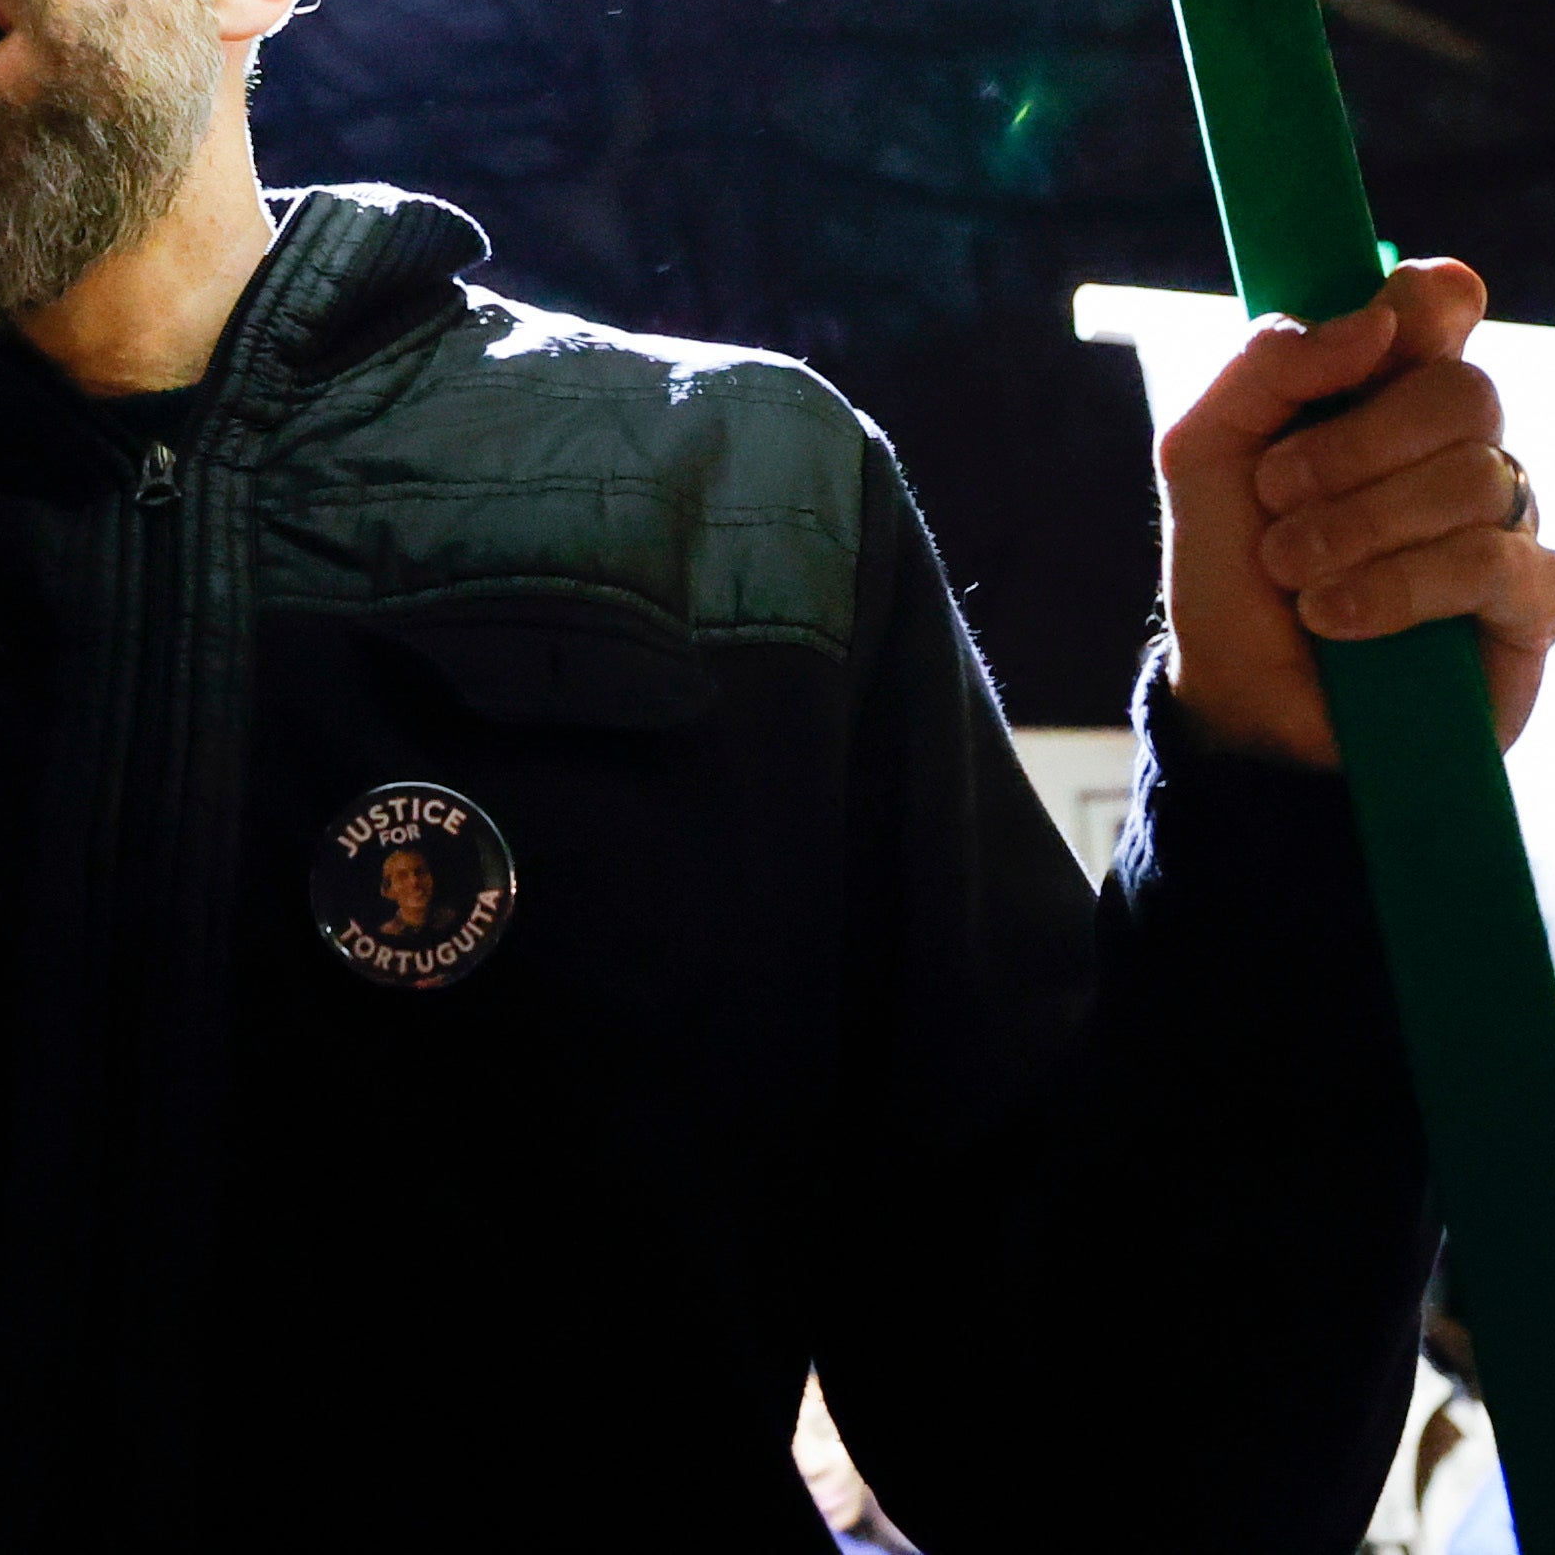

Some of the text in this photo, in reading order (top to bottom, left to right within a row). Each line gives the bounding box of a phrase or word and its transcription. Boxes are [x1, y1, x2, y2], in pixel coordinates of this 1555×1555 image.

[338, 797, 467, 859] JUSTICE
[379, 823, 421, 847] FOR
[339, 889, 501, 975] TORTUGUITA
